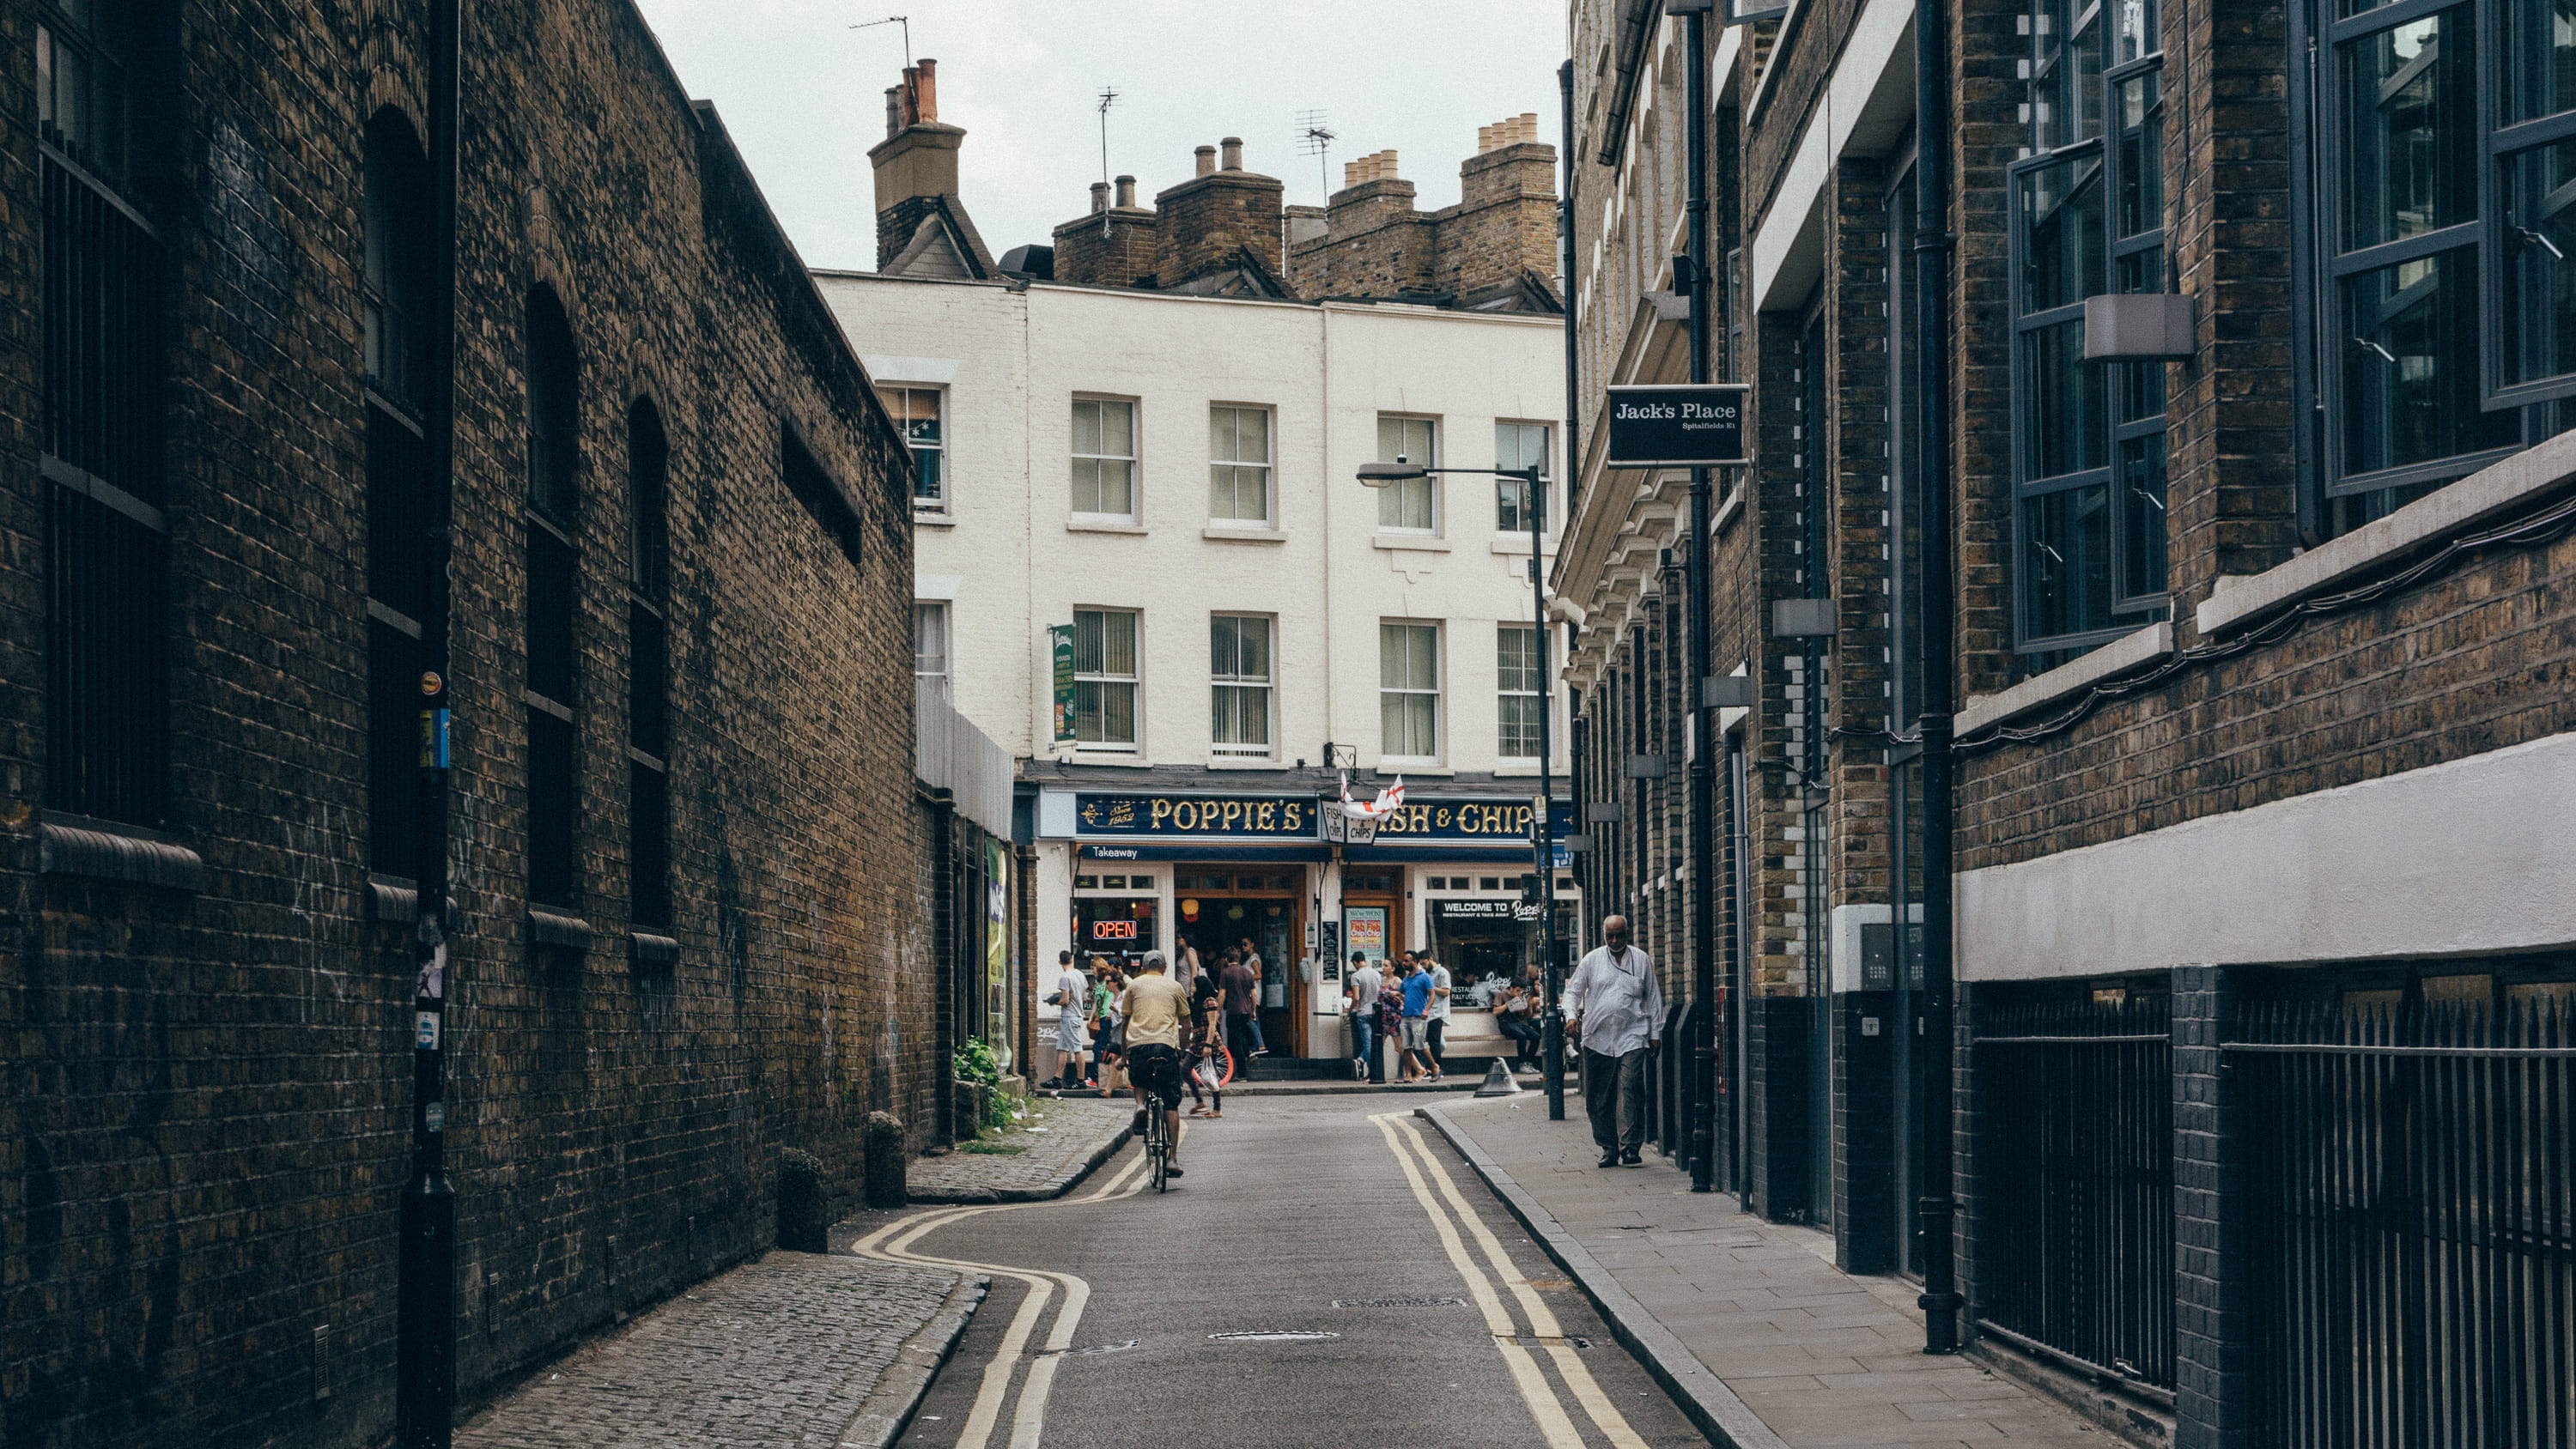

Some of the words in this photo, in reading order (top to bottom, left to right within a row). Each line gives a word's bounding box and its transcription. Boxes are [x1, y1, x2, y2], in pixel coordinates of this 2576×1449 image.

[1616, 403, 1675, 419] Jack's
[1681, 403, 1736, 419] Place
[1108, 812, 1135, 826] 1952
[1151, 798, 1302, 831] POPPIE'S
[1326, 807, 1342, 821] FISH
[1436, 808, 1452, 828] &
[1456, 803, 1534, 834] CHIP
[1350, 828, 1371, 839] CHIPS
[1092, 846, 1138, 860] Takeaway
[1444, 903, 1492, 912] WELCOME
[1494, 903, 1508, 912] TO
[1095, 922, 1135, 938] OPEN
